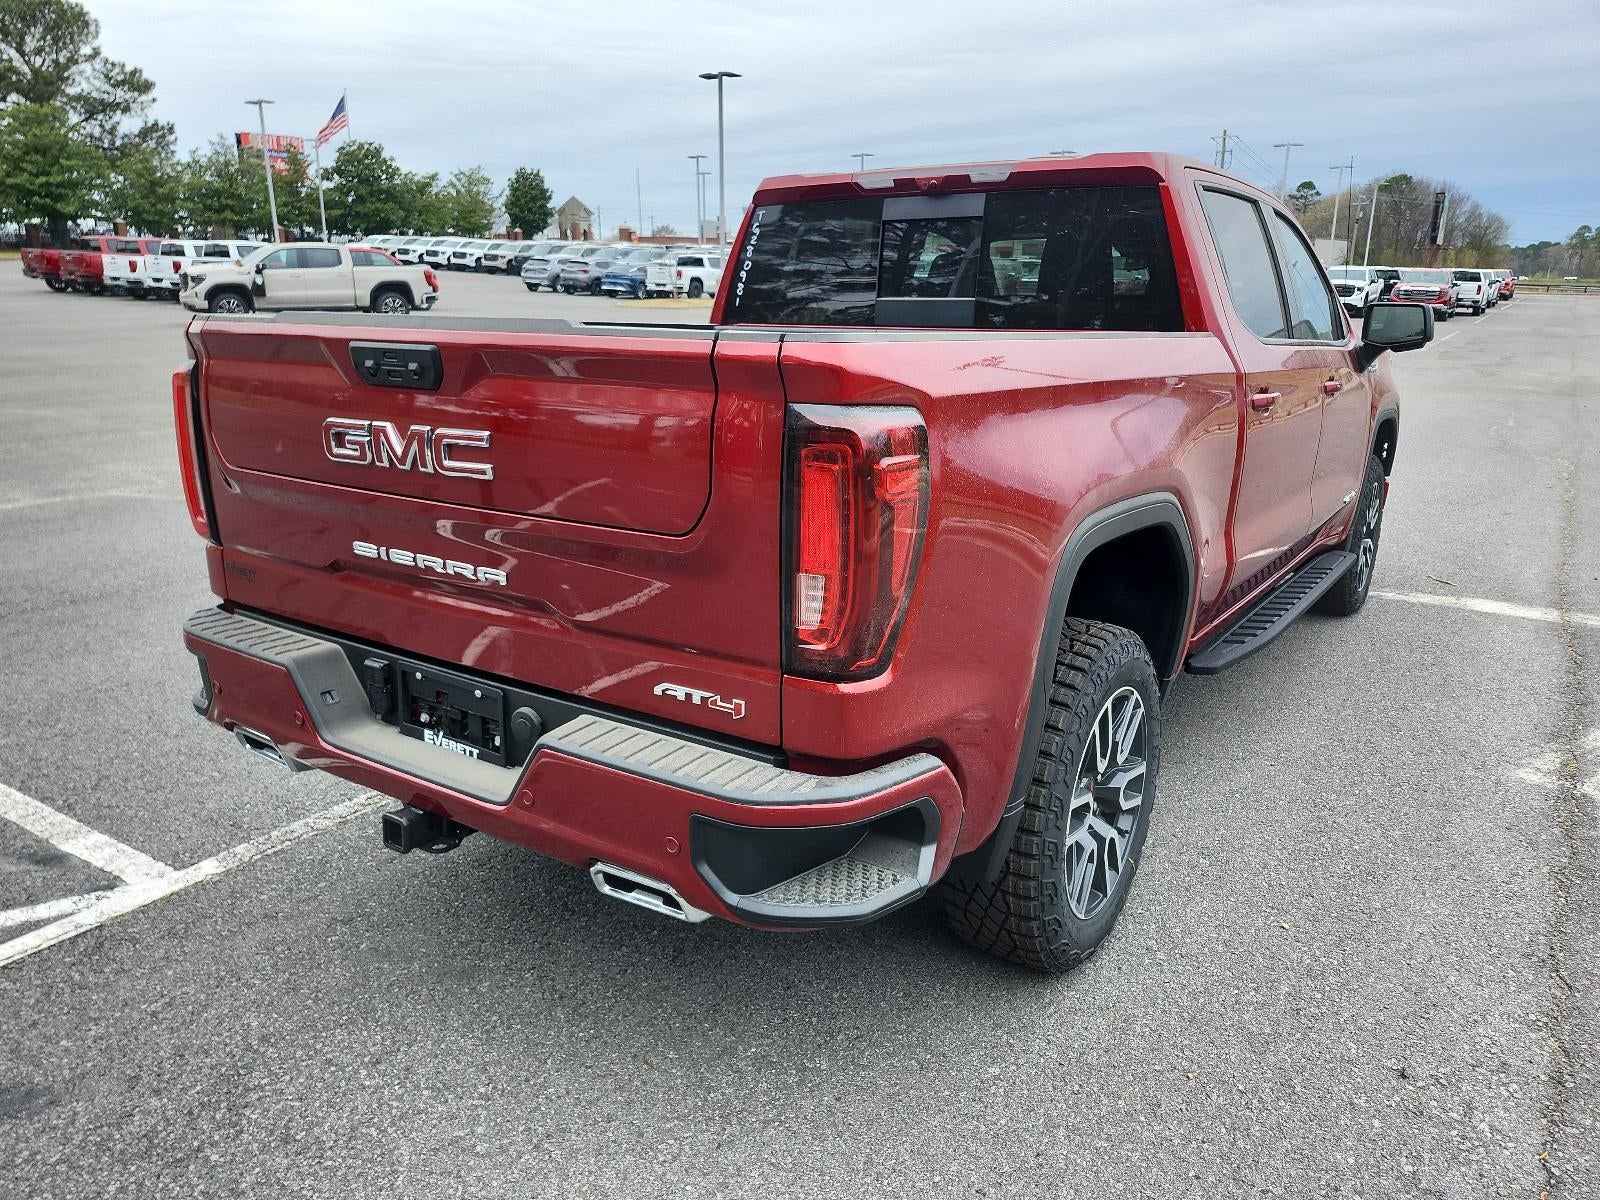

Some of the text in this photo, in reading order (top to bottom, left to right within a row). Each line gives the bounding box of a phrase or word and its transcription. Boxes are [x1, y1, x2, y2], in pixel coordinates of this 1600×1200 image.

[322, 416, 495, 481] GMC
[352, 540, 508, 586] SIERRA
[653, 682, 746, 720] AT4
[423, 728, 480, 759] EVERETT
